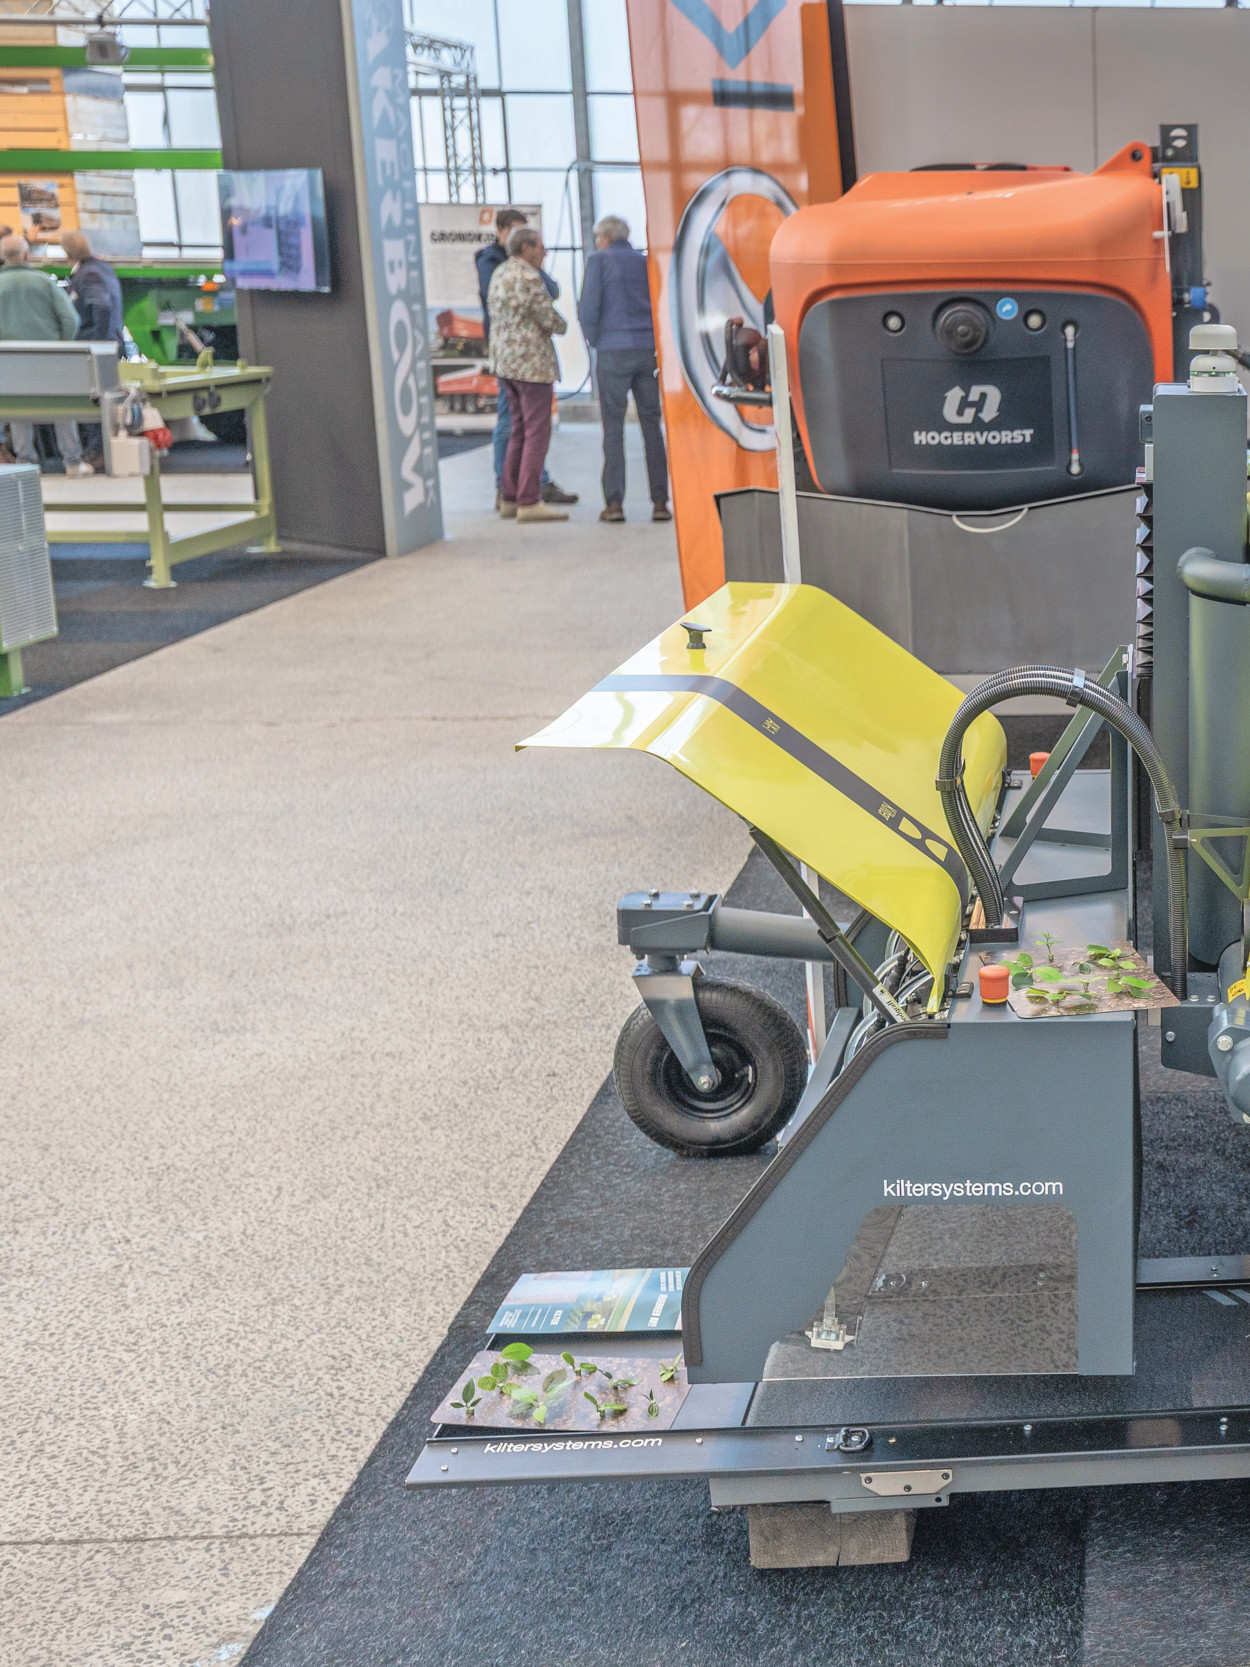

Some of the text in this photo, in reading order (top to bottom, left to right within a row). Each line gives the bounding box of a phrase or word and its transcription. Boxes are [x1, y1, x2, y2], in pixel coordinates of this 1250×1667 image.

[913, 429, 1034, 446] HOGERVORST
[883, 1179, 1064, 1200] kiltersystems.com
[483, 1436, 663, 1454] kiltersystems.com
